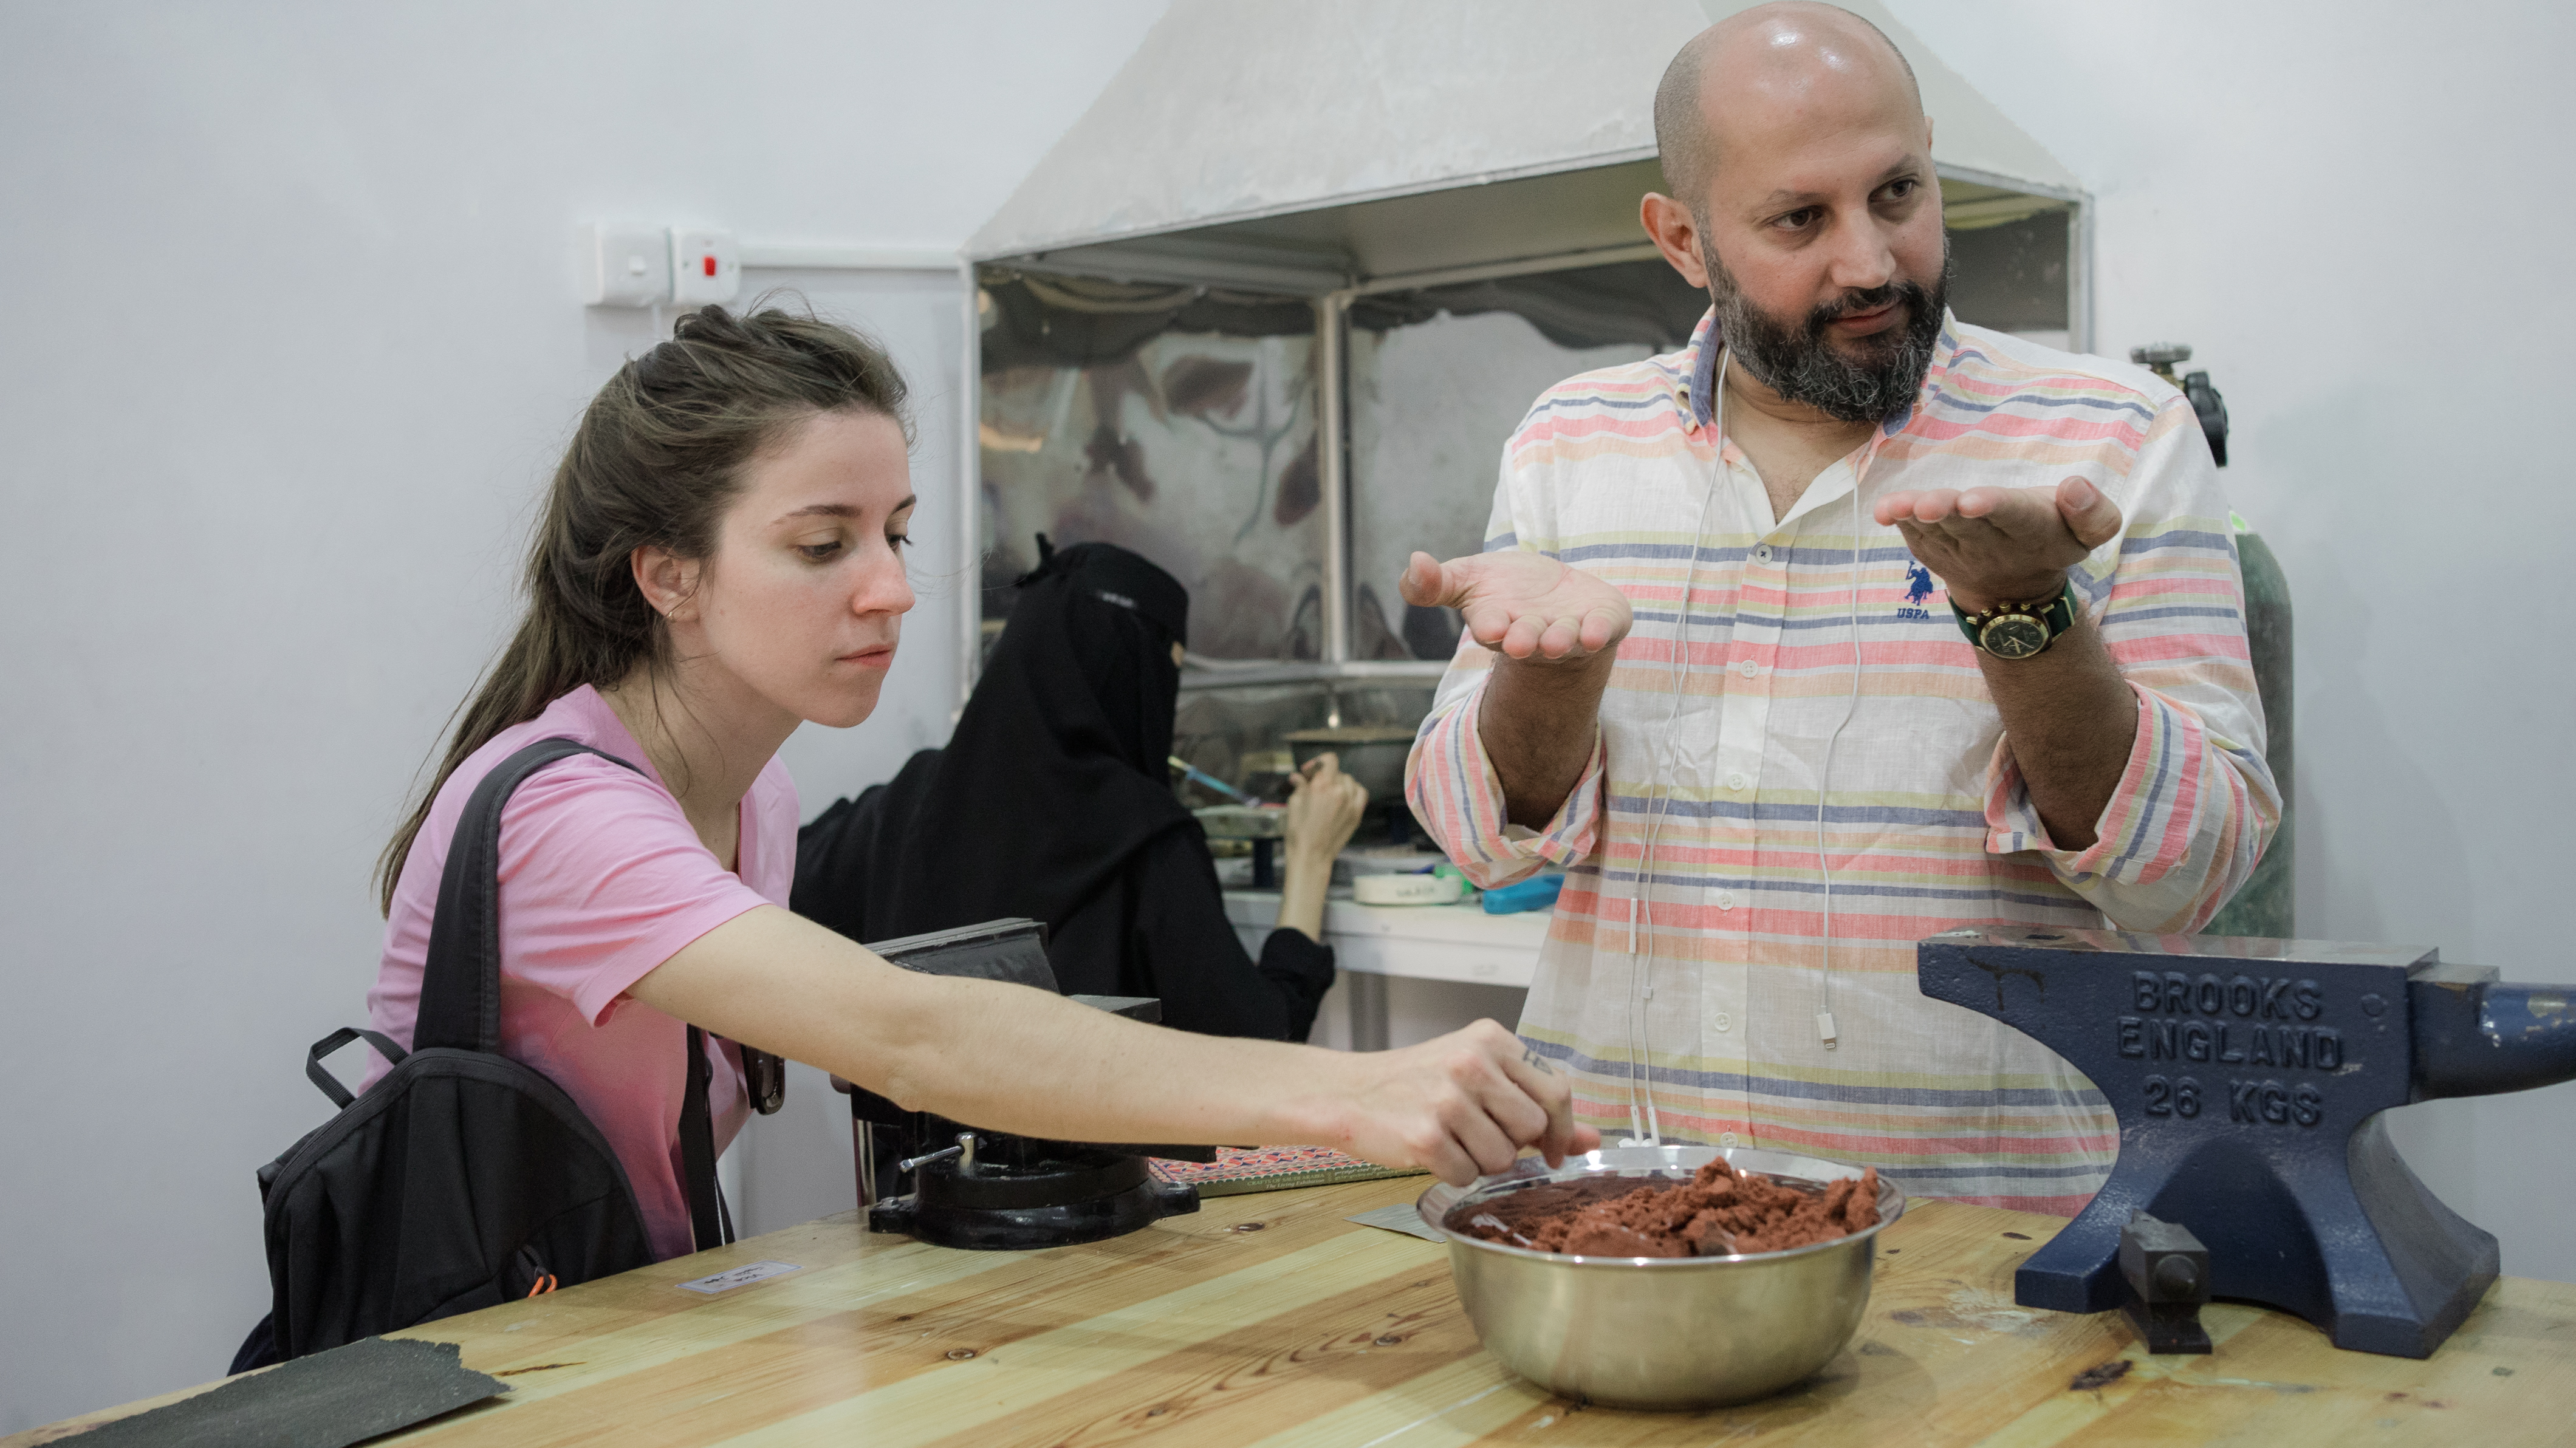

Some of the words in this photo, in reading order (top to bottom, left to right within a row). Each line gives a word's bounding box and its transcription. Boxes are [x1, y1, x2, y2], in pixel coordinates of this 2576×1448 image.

[1897, 608, 1930, 620] USPA
[2133, 971, 2321, 1021] BROOKS
[2119, 1016, 2343, 1070] ENGLAND
[2144, 1074, 2201, 1118] 26
[2229, 1077, 2322, 1127] KGS
